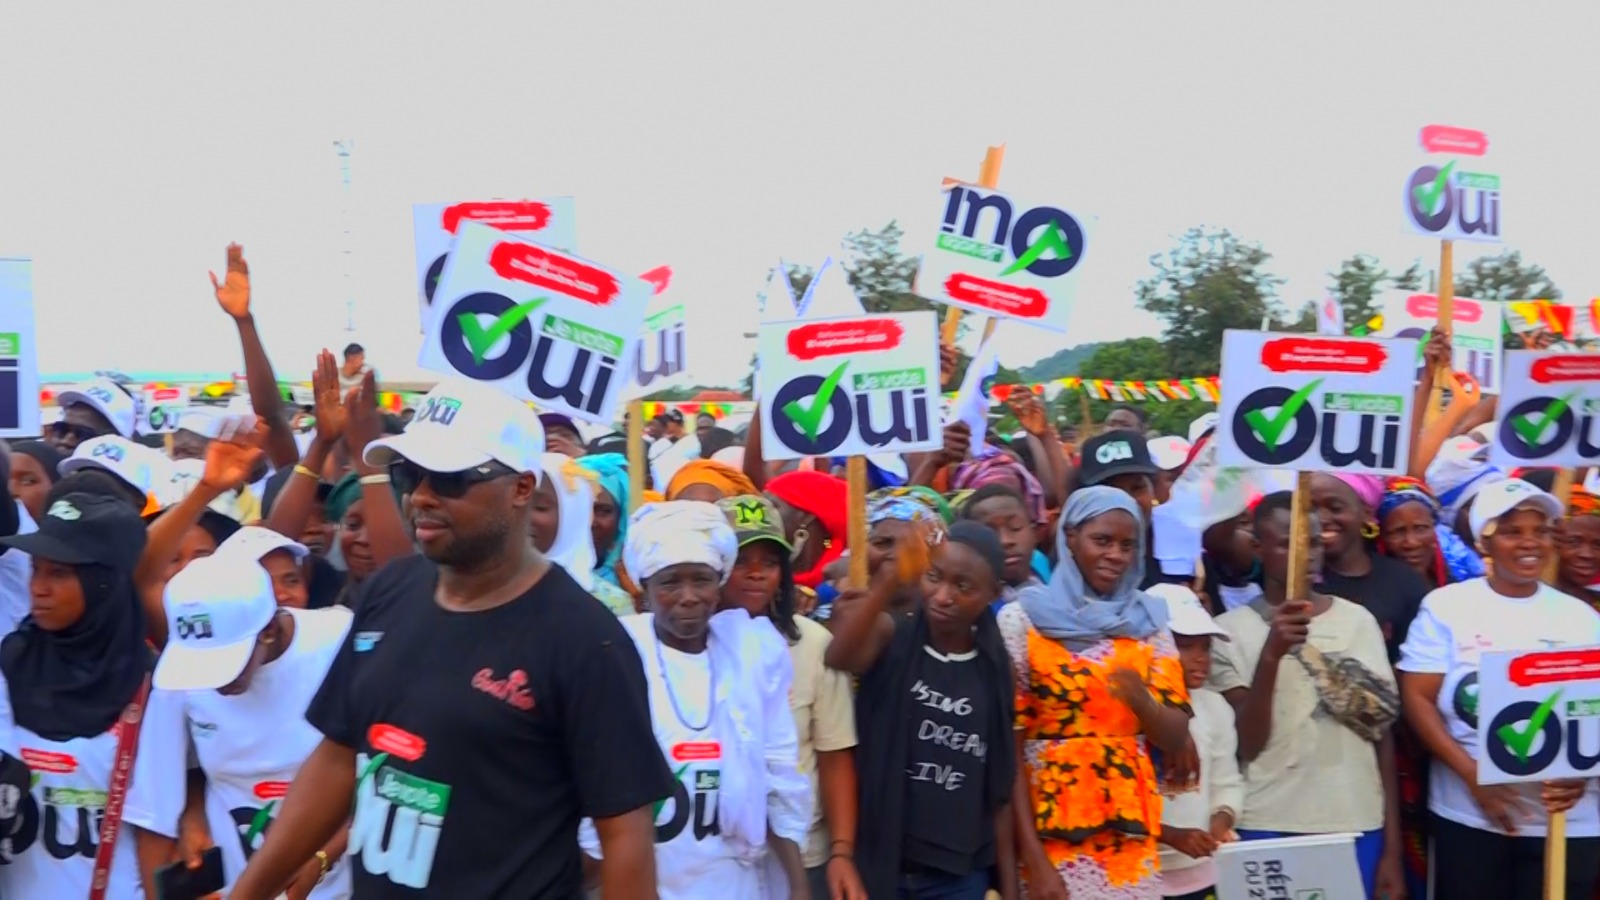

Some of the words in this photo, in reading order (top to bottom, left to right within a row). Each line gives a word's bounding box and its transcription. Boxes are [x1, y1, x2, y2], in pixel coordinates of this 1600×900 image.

[942, 186, 1084, 278] Oui
[1409, 165, 1499, 236] Oui
[441, 292, 617, 417] Oui
[636, 321, 684, 387] ui
[855, 373, 880, 390] Je
[881, 371, 921, 387] vote
[772, 374, 929, 455] Oui
[1233, 386, 1400, 469] Oui
[1487, 701, 1600, 777] Ou
[904, 762, 967, 790] IVE
[1243, 861, 1262, 885] DU
[1248, 888, 1267, 900] 2
